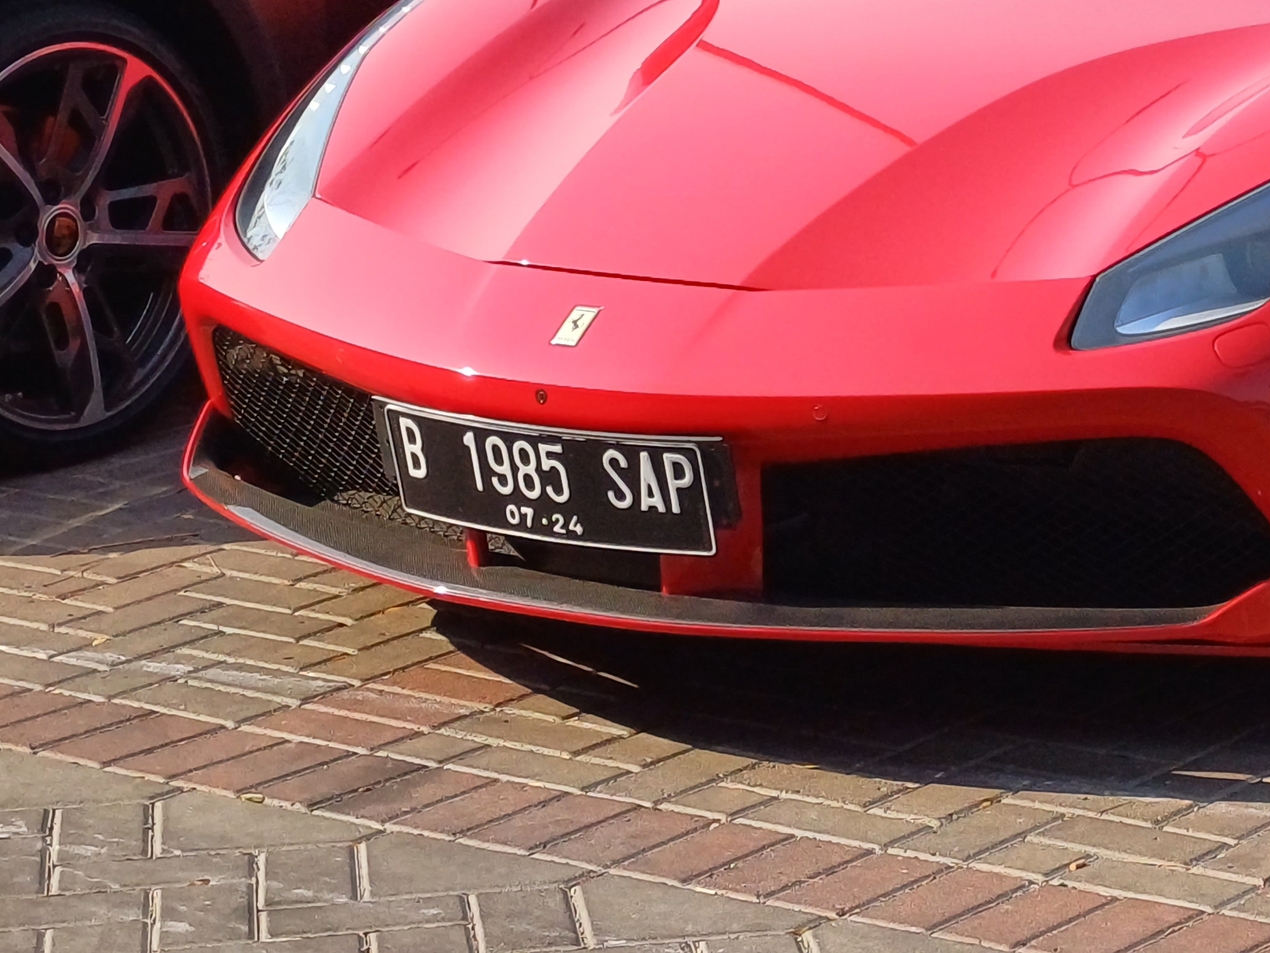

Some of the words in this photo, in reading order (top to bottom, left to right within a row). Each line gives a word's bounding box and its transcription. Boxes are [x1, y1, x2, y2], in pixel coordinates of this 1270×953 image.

[399, 414, 428, 479] B
[463, 431, 571, 503] 1985
[602, 449, 694, 514] SAP
